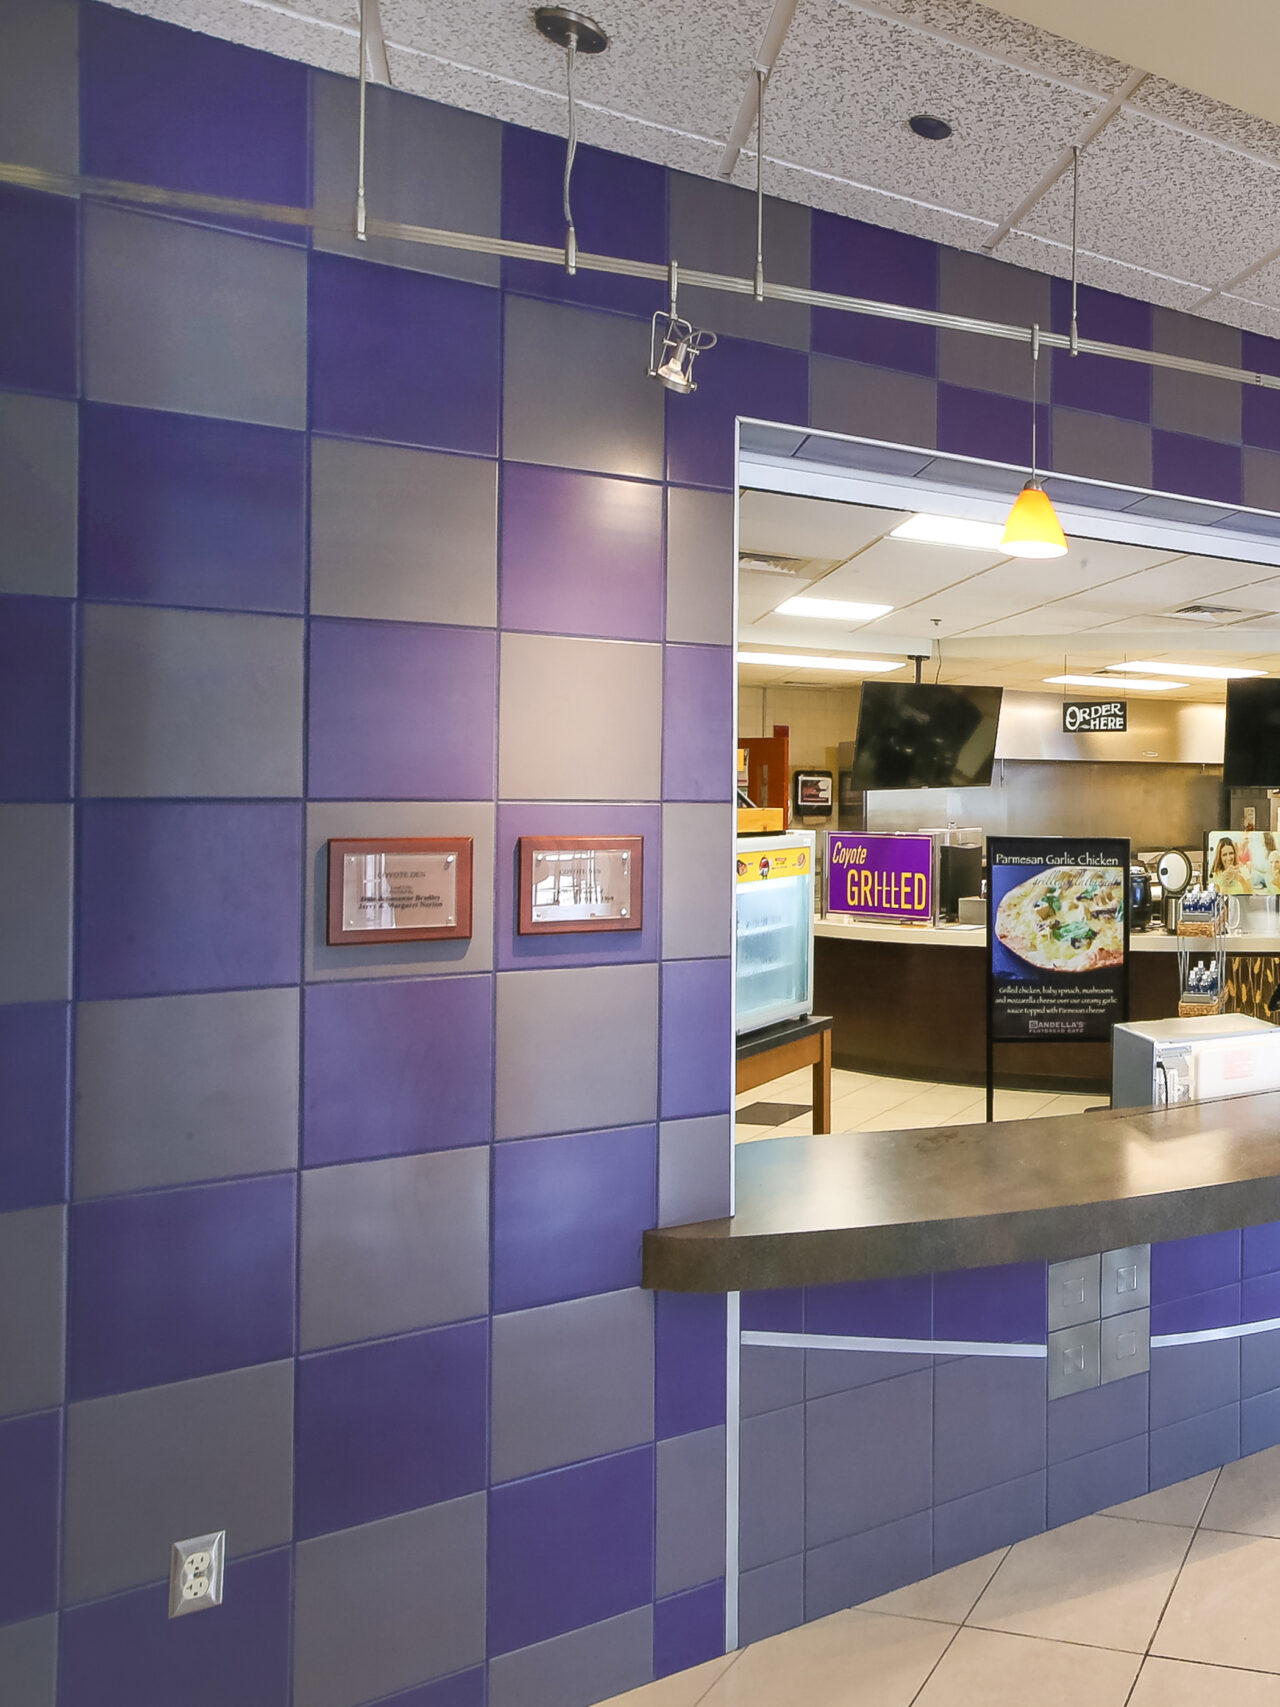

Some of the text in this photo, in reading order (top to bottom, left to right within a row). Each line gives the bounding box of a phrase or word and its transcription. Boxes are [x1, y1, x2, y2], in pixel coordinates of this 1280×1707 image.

[1065, 703, 1124, 730] ORDER
[1090, 717, 1124, 730] HERE
[832, 841, 867, 869] Coyote
[996, 851, 1118, 865] Parmesan Garlic Chicken
[847, 869, 927, 910] GRILLED
[1042, 985, 1057, 996] baby
[1024, 1006, 1045, 1016] topped
[1029, 1020, 1084, 1028] SANDELLA'S
